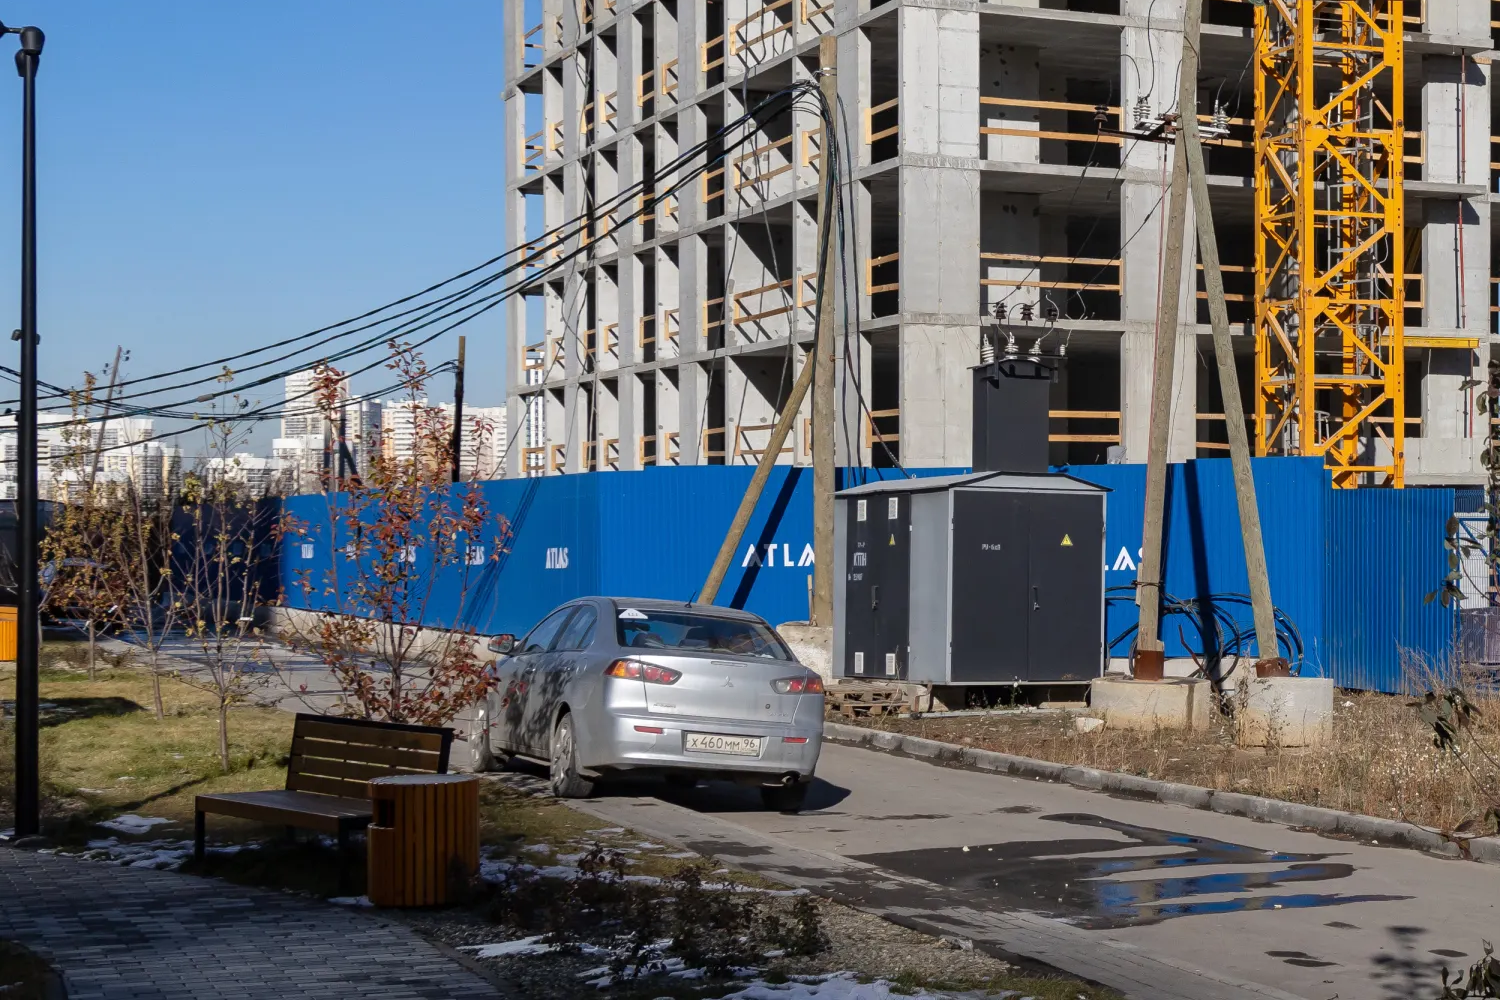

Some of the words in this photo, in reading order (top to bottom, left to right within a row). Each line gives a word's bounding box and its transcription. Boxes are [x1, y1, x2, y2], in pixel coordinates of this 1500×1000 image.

[545, 547, 569, 569] ATLAS
[742, 543, 815, 567] ATLA
[743, 738, 756, 749] 96
